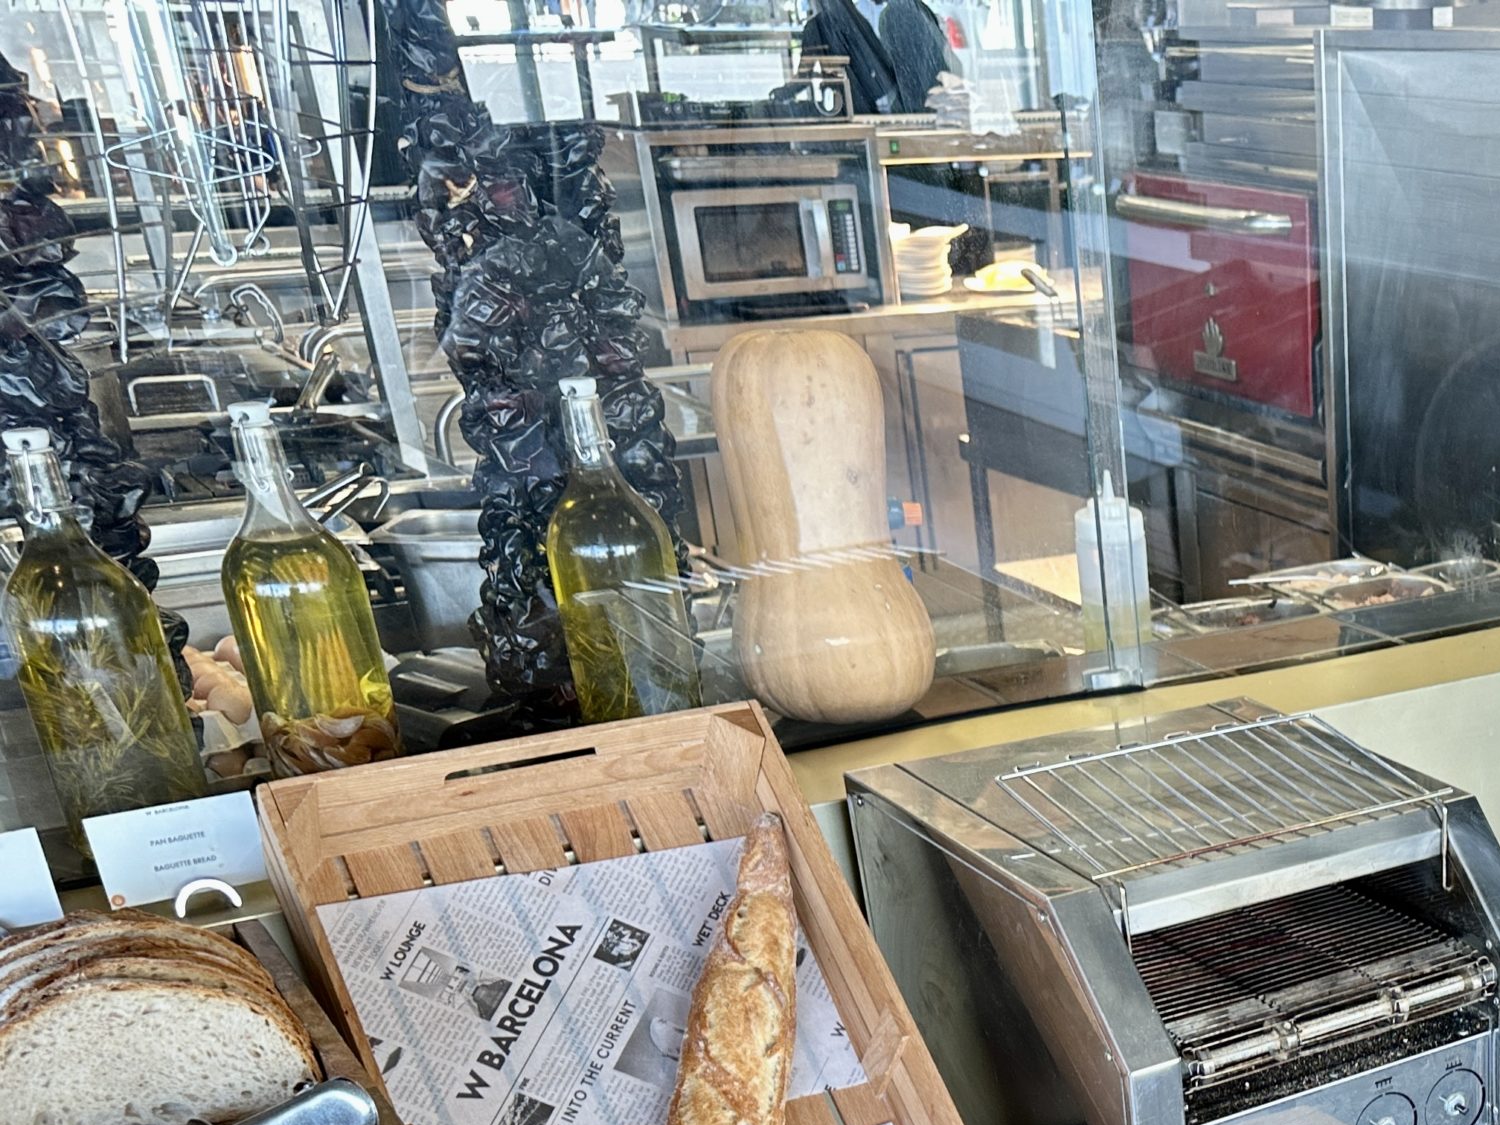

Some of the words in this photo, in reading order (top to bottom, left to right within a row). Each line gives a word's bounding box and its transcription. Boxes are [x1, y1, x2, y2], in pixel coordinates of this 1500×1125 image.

[150, 837, 167, 847] PAN
[167, 831, 206, 844] BAGUETTE
[154, 859, 193, 873] BAGUETTE
[193, 854, 217, 866] BREAD
[692, 919, 711, 948] WET
[708, 891, 732, 920] DECK
[380, 966, 396, 981] W
[391, 920, 426, 967] LOUNGE
[456, 1070, 491, 1100] W
[476, 924, 583, 1071] BARCELONA
[562, 1090, 587, 1125] INTO
[581, 1061, 604, 1088] THE
[597, 999, 637, 1060] CURRENT
